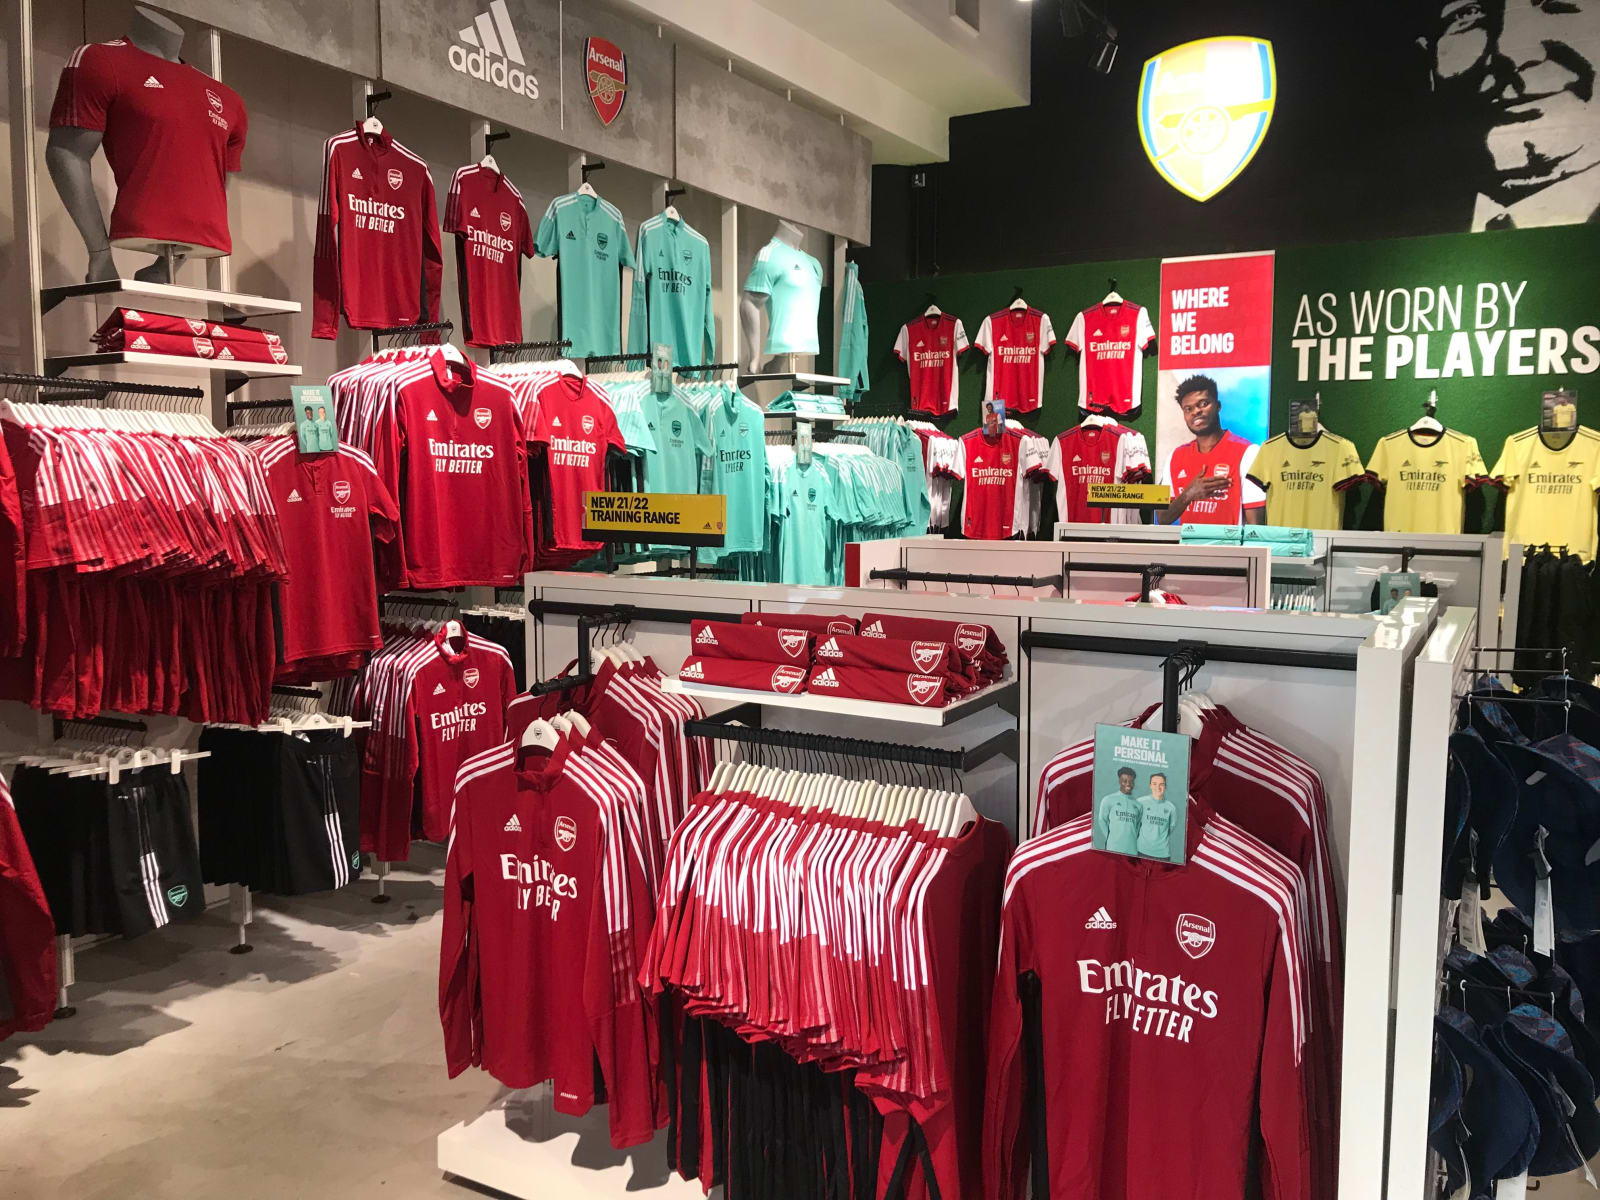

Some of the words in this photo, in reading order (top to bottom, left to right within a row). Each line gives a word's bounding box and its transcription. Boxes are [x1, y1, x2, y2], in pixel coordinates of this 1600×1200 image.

[588, 47, 624, 73] Arsenal
[448, 45, 540, 100] adidas
[347, 193, 405, 220] Emirates
[355, 214, 367, 229] FLY
[467, 224, 514, 252] Emirates
[473, 243, 486, 257] FLY
[1171, 286, 1230, 310] WHERE
[1292, 292, 1338, 338] AS
[1350, 284, 1463, 335] WORN
[1475, 280, 1528, 330] BY
[1171, 311, 1197, 333] WE
[998, 345, 1036, 356] Emirates
[1090, 340, 1132, 352] Emirates
[1170, 332, 1235, 356] BELONG
[913, 350, 951, 362] Emirates
[1291, 335, 1374, 382] THE
[1385, 325, 1600, 380] PLAYERS
[428, 438, 495, 459] Emirates
[550, 434, 597, 455] Emirates
[435, 458, 447, 473] FLY
[448, 459, 483, 474] BETTER
[554, 452, 566, 465] FLY
[971, 466, 1013, 478] Emirates
[1072, 464, 1111, 476] Emirates
[1400, 469, 1447, 483] Emirates
[1528, 472, 1582, 484] Emirates
[591, 496, 615, 509] NEW
[617, 497, 649, 510] 21/22
[591, 510, 642, 522] TRAINING
[643, 511, 681, 525] RANGE
[861, 630, 887, 640] adidas
[960, 628, 982, 637] Arsenal
[695, 636, 719, 646] adidas
[817, 649, 844, 658] adidas
[680, 670, 705, 679] adidas
[811, 679, 840, 688] adidas
[430, 701, 487, 730] Emites
[442, 725, 455, 743] FLY
[1121, 735, 1150, 750] MAKE
[1151, 739, 1162, 751] IT
[1114, 746, 1168, 765] PERSONAL
[503, 825, 523, 833] adidas
[517, 885, 531, 911] LY
[535, 884, 561, 922] BER
[1084, 920, 1117, 930] adidas
[1182, 919, 1211, 934] Arsenal
[1105, 993, 1133, 1025] FLY
[1131, 1003, 1194, 1043] ETTER
